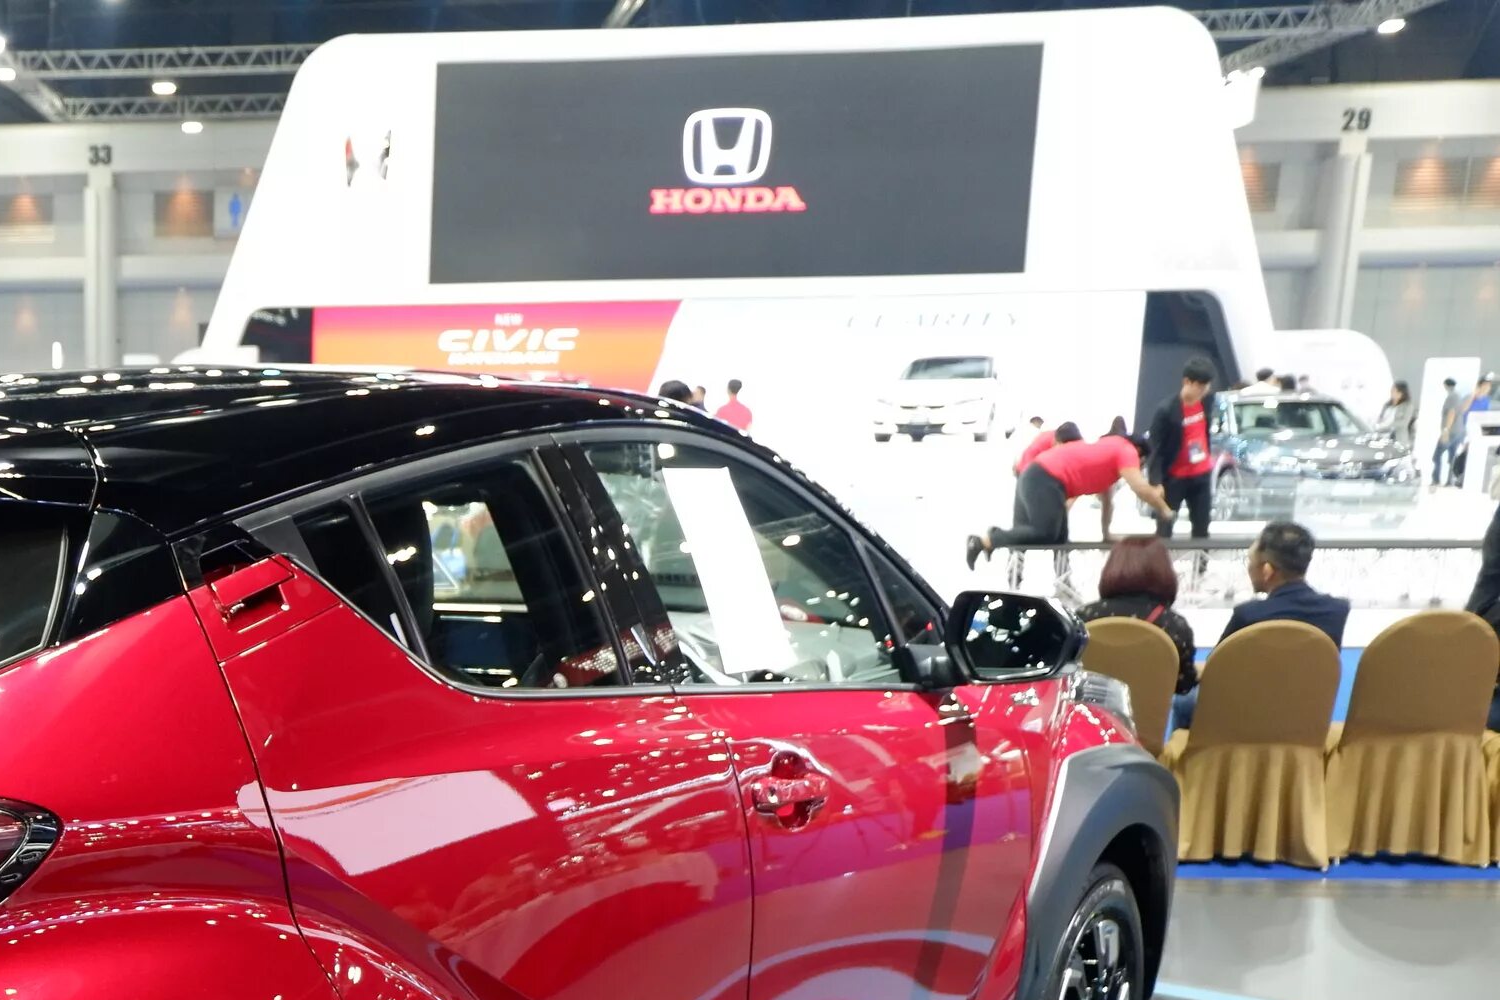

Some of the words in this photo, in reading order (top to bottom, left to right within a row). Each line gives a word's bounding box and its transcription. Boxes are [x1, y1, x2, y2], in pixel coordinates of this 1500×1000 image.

[1341, 107, 1372, 131] 29
[88, 144, 112, 166] 33
[649, 186, 807, 214] HONDA
[437, 327, 580, 352] CIVIC
